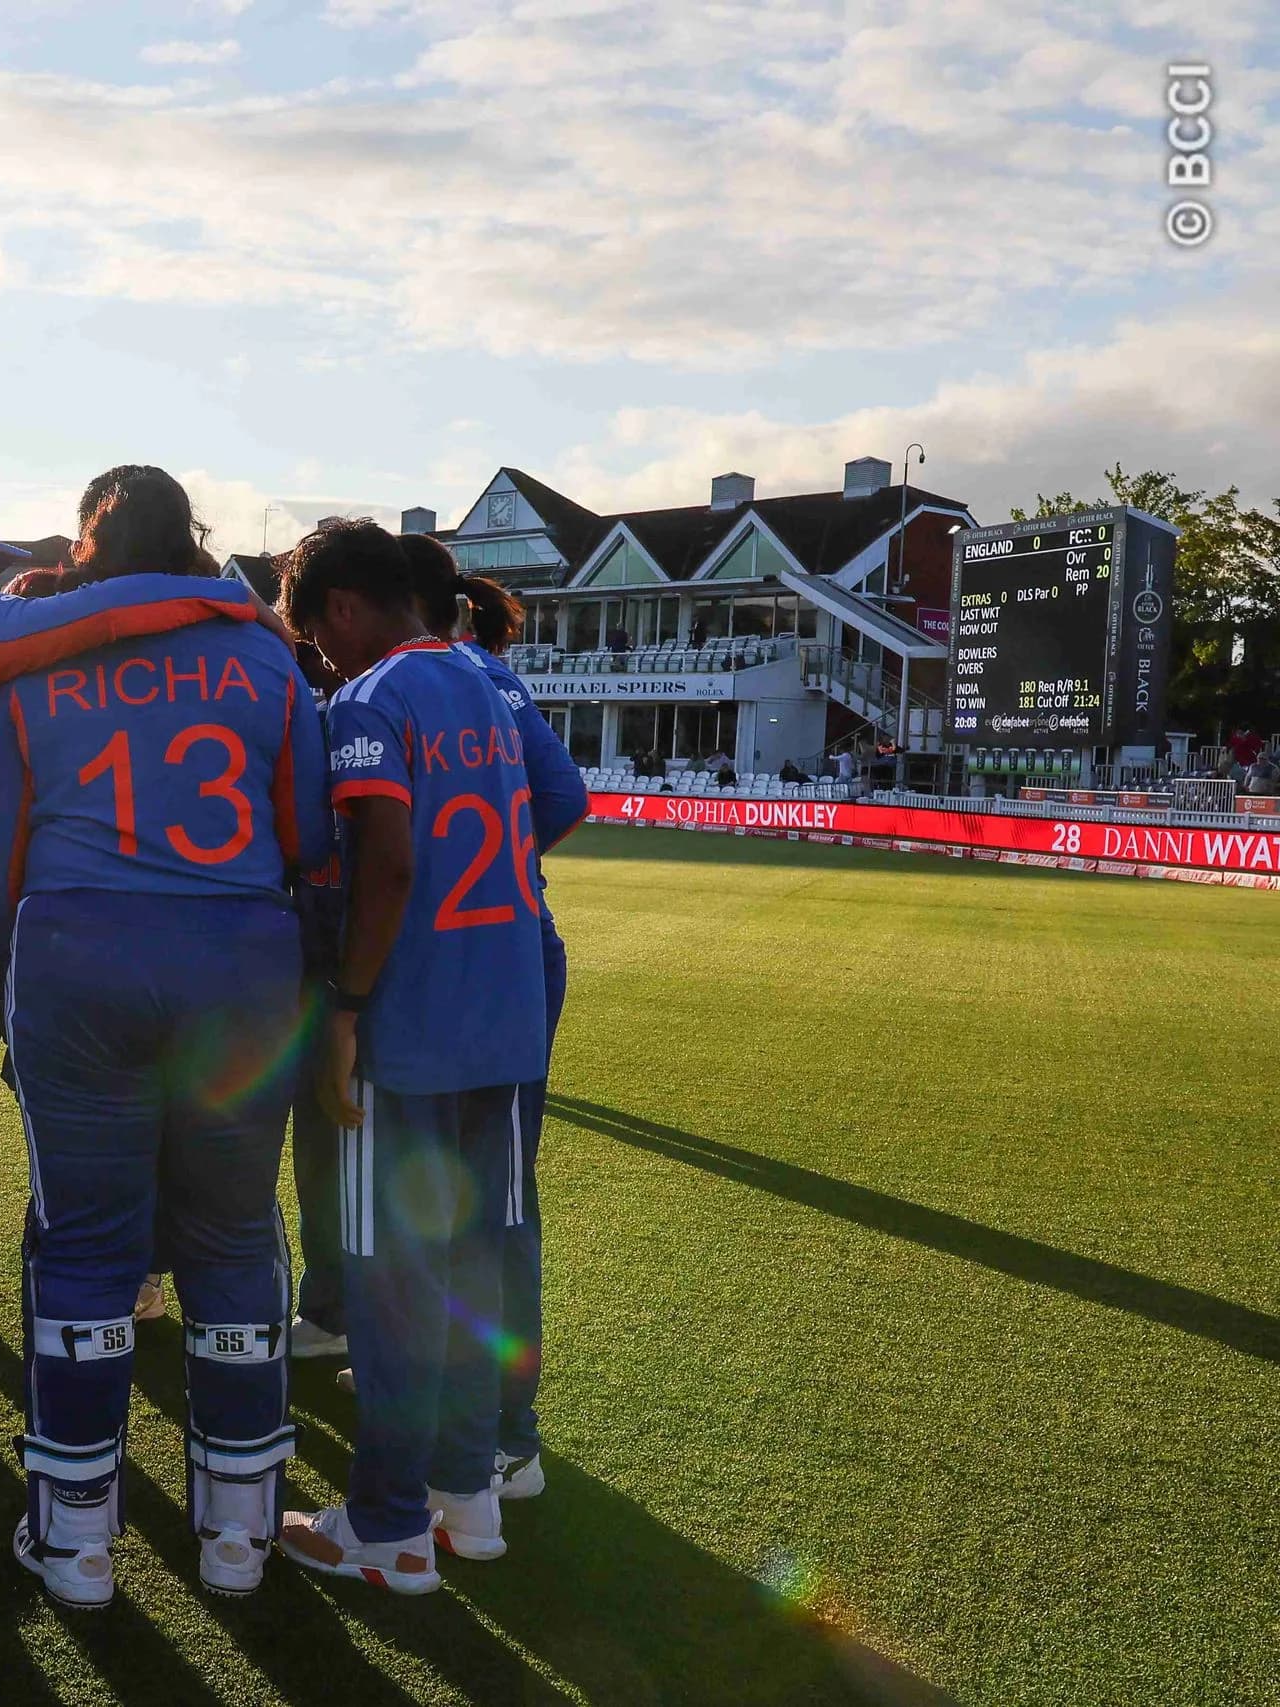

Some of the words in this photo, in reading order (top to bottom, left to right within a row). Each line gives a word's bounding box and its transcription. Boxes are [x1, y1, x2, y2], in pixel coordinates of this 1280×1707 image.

[1094, 512, 1113, 521] BLACK
[1040, 521, 1057, 529] BLACK
[988, 528, 1003, 537] BLACK
[966, 540, 1013, 558] ENGLAND
[1033, 536, 1040, 549] 0
[1098, 526, 1105, 540] 0
[1066, 551, 1086, 565] Ovr
[1104, 548, 1111, 560] 0
[1066, 568, 1090, 582] Rem
[1096, 565, 1109, 578] 20
[961, 593, 991, 607] EXTRAS
[1001, 592, 1007, 603] 0
[1017, 589, 1033, 602] DLS
[1035, 588, 1049, 600] Par
[1051, 586, 1058, 598] 0
[1076, 583, 1088, 596] PP
[960, 608, 980, 621] LAST
[981, 606, 1000, 619] WKT
[924, 620, 936, 630] THE
[960, 624, 978, 635] HOW
[981, 622, 998, 634] OUT
[958, 647, 997, 660] BOWLERS
[957, 662, 984, 675] OVERS
[48, 656, 259, 718] RICHA
[530, 681, 612, 694] MICHAEL
[617, 681, 687, 694] SPIERS
[696, 688, 724, 697] ROLEX
[956, 683, 979, 695] INDIA
[1020, 681, 1036, 693] 180
[1038, 680, 1054, 695] Req
[1057, 679, 1073, 693] R/R
[1075, 679, 1088, 692] 9.1
[1136, 659, 1151, 712] BLACK
[955, 698, 968, 710] TO
[969, 697, 986, 709] WIN
[1019, 696, 1034, 709] 181
[1037, 696, 1052, 708] Cut
[1055, 694, 1069, 708] Off
[1073, 695, 1100, 707] 21:24
[955, 717, 977, 729] 20:08
[1002, 715, 1029, 728] dafabet
[1059, 714, 1089, 728] dafabet
[422, 731, 449, 774] K
[336, 756, 381, 770] TYRES
[78, 723, 254, 865] 13
[621, 797, 645, 818] 47
[666, 799, 740, 825] SOPHIA
[745, 803, 838, 828] DUNKLEY
[1051, 824, 1081, 852] 28
[1102, 827, 1196, 864] DANNI
[102, 1326, 126, 1351] SS
[216, 1330, 245, 1352] SS
